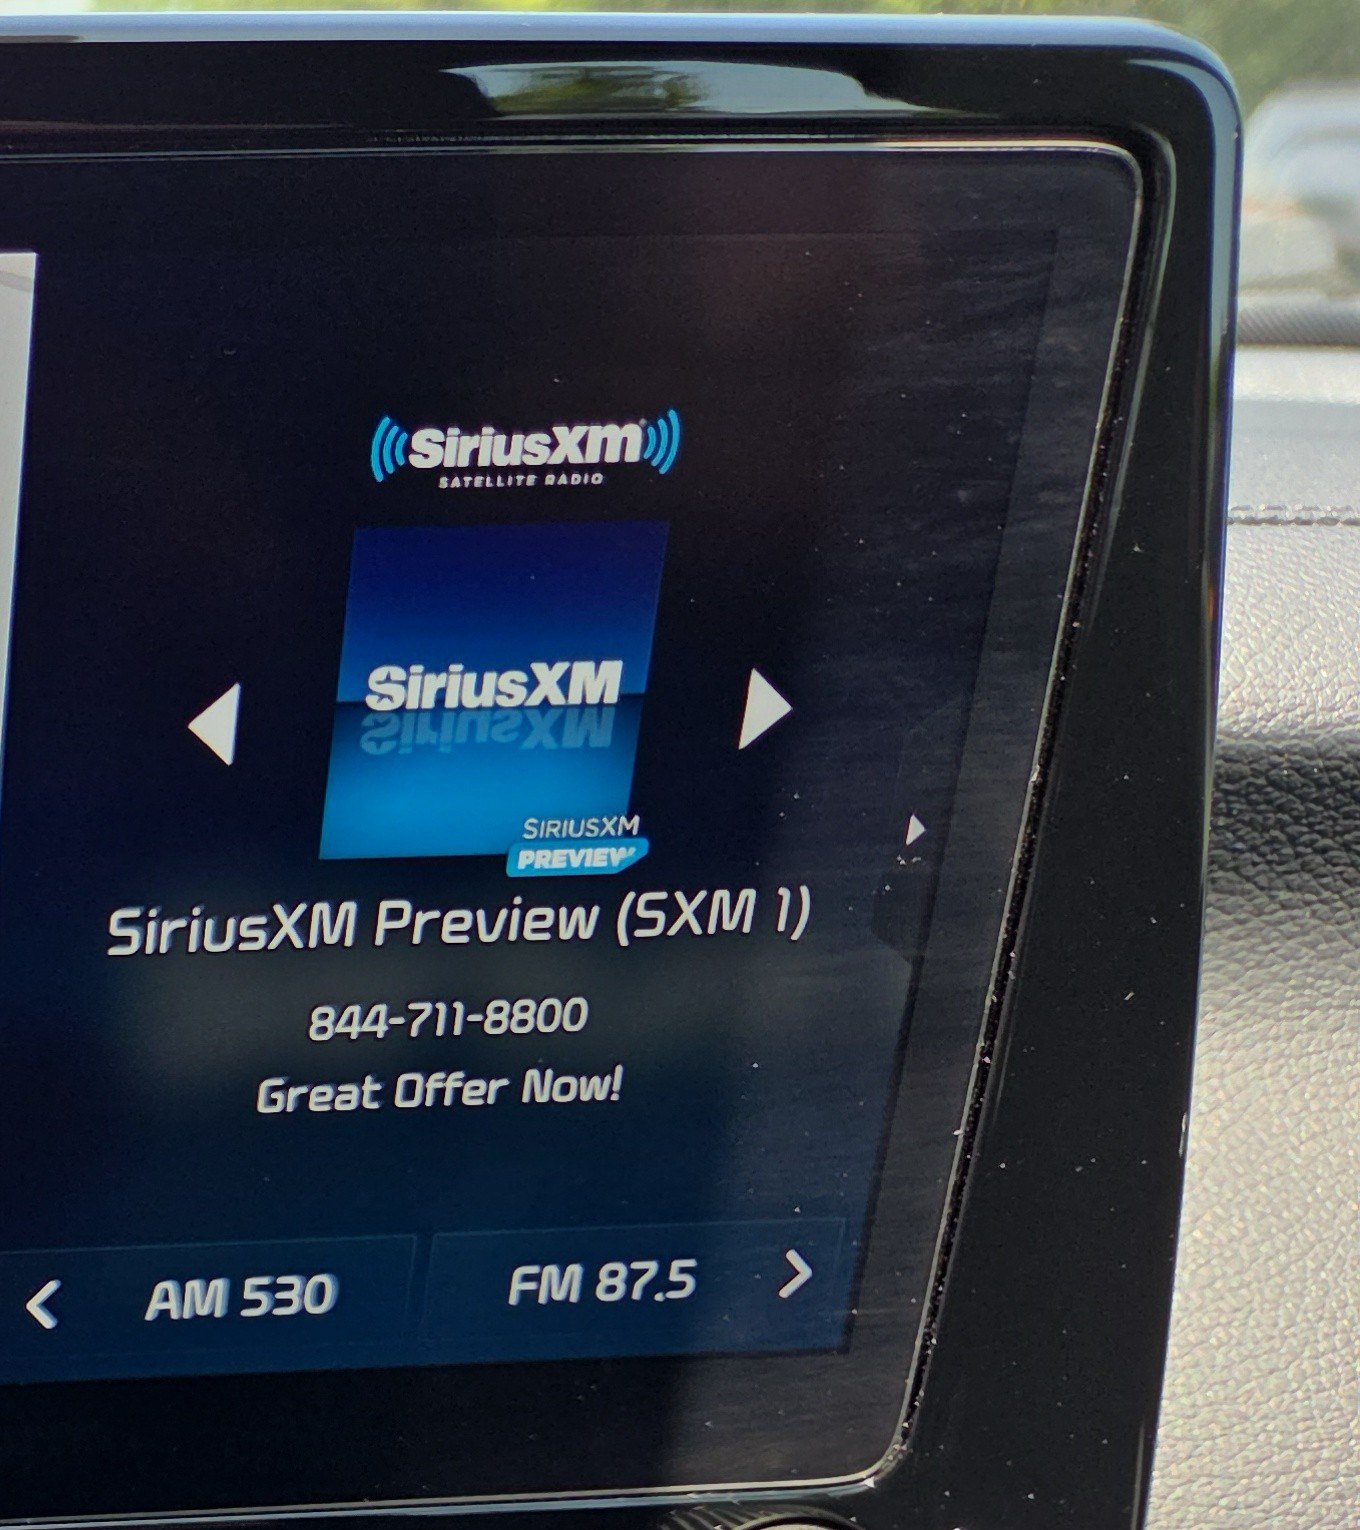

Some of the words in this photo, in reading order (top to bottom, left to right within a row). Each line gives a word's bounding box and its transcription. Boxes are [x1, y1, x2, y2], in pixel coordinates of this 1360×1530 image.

[437, 473, 538, 489] SATELLITE
[544, 471, 604, 486] RADIO
[365, 659, 624, 711] SiriusXM
[522, 814, 640, 840] SIRIUSXM
[517, 846, 637, 871] PREVIEW
[107, 900, 358, 956] SiriusXM
[374, 895, 601, 946] Preview
[616, 888, 757, 947] (SXM
[777, 884, 812, 941] 1)
[308, 996, 590, 1042] 844-711-8800
[256, 1074, 384, 1114] Great
[394, 1070, 511, 1109] Offer
[521, 1064, 624, 1104] Now!
[143, 1277, 230, 1322] AM
[239, 1272, 338, 1317] 530
[507, 1262, 585, 1306] FM
[595, 1258, 698, 1303] 87.5
